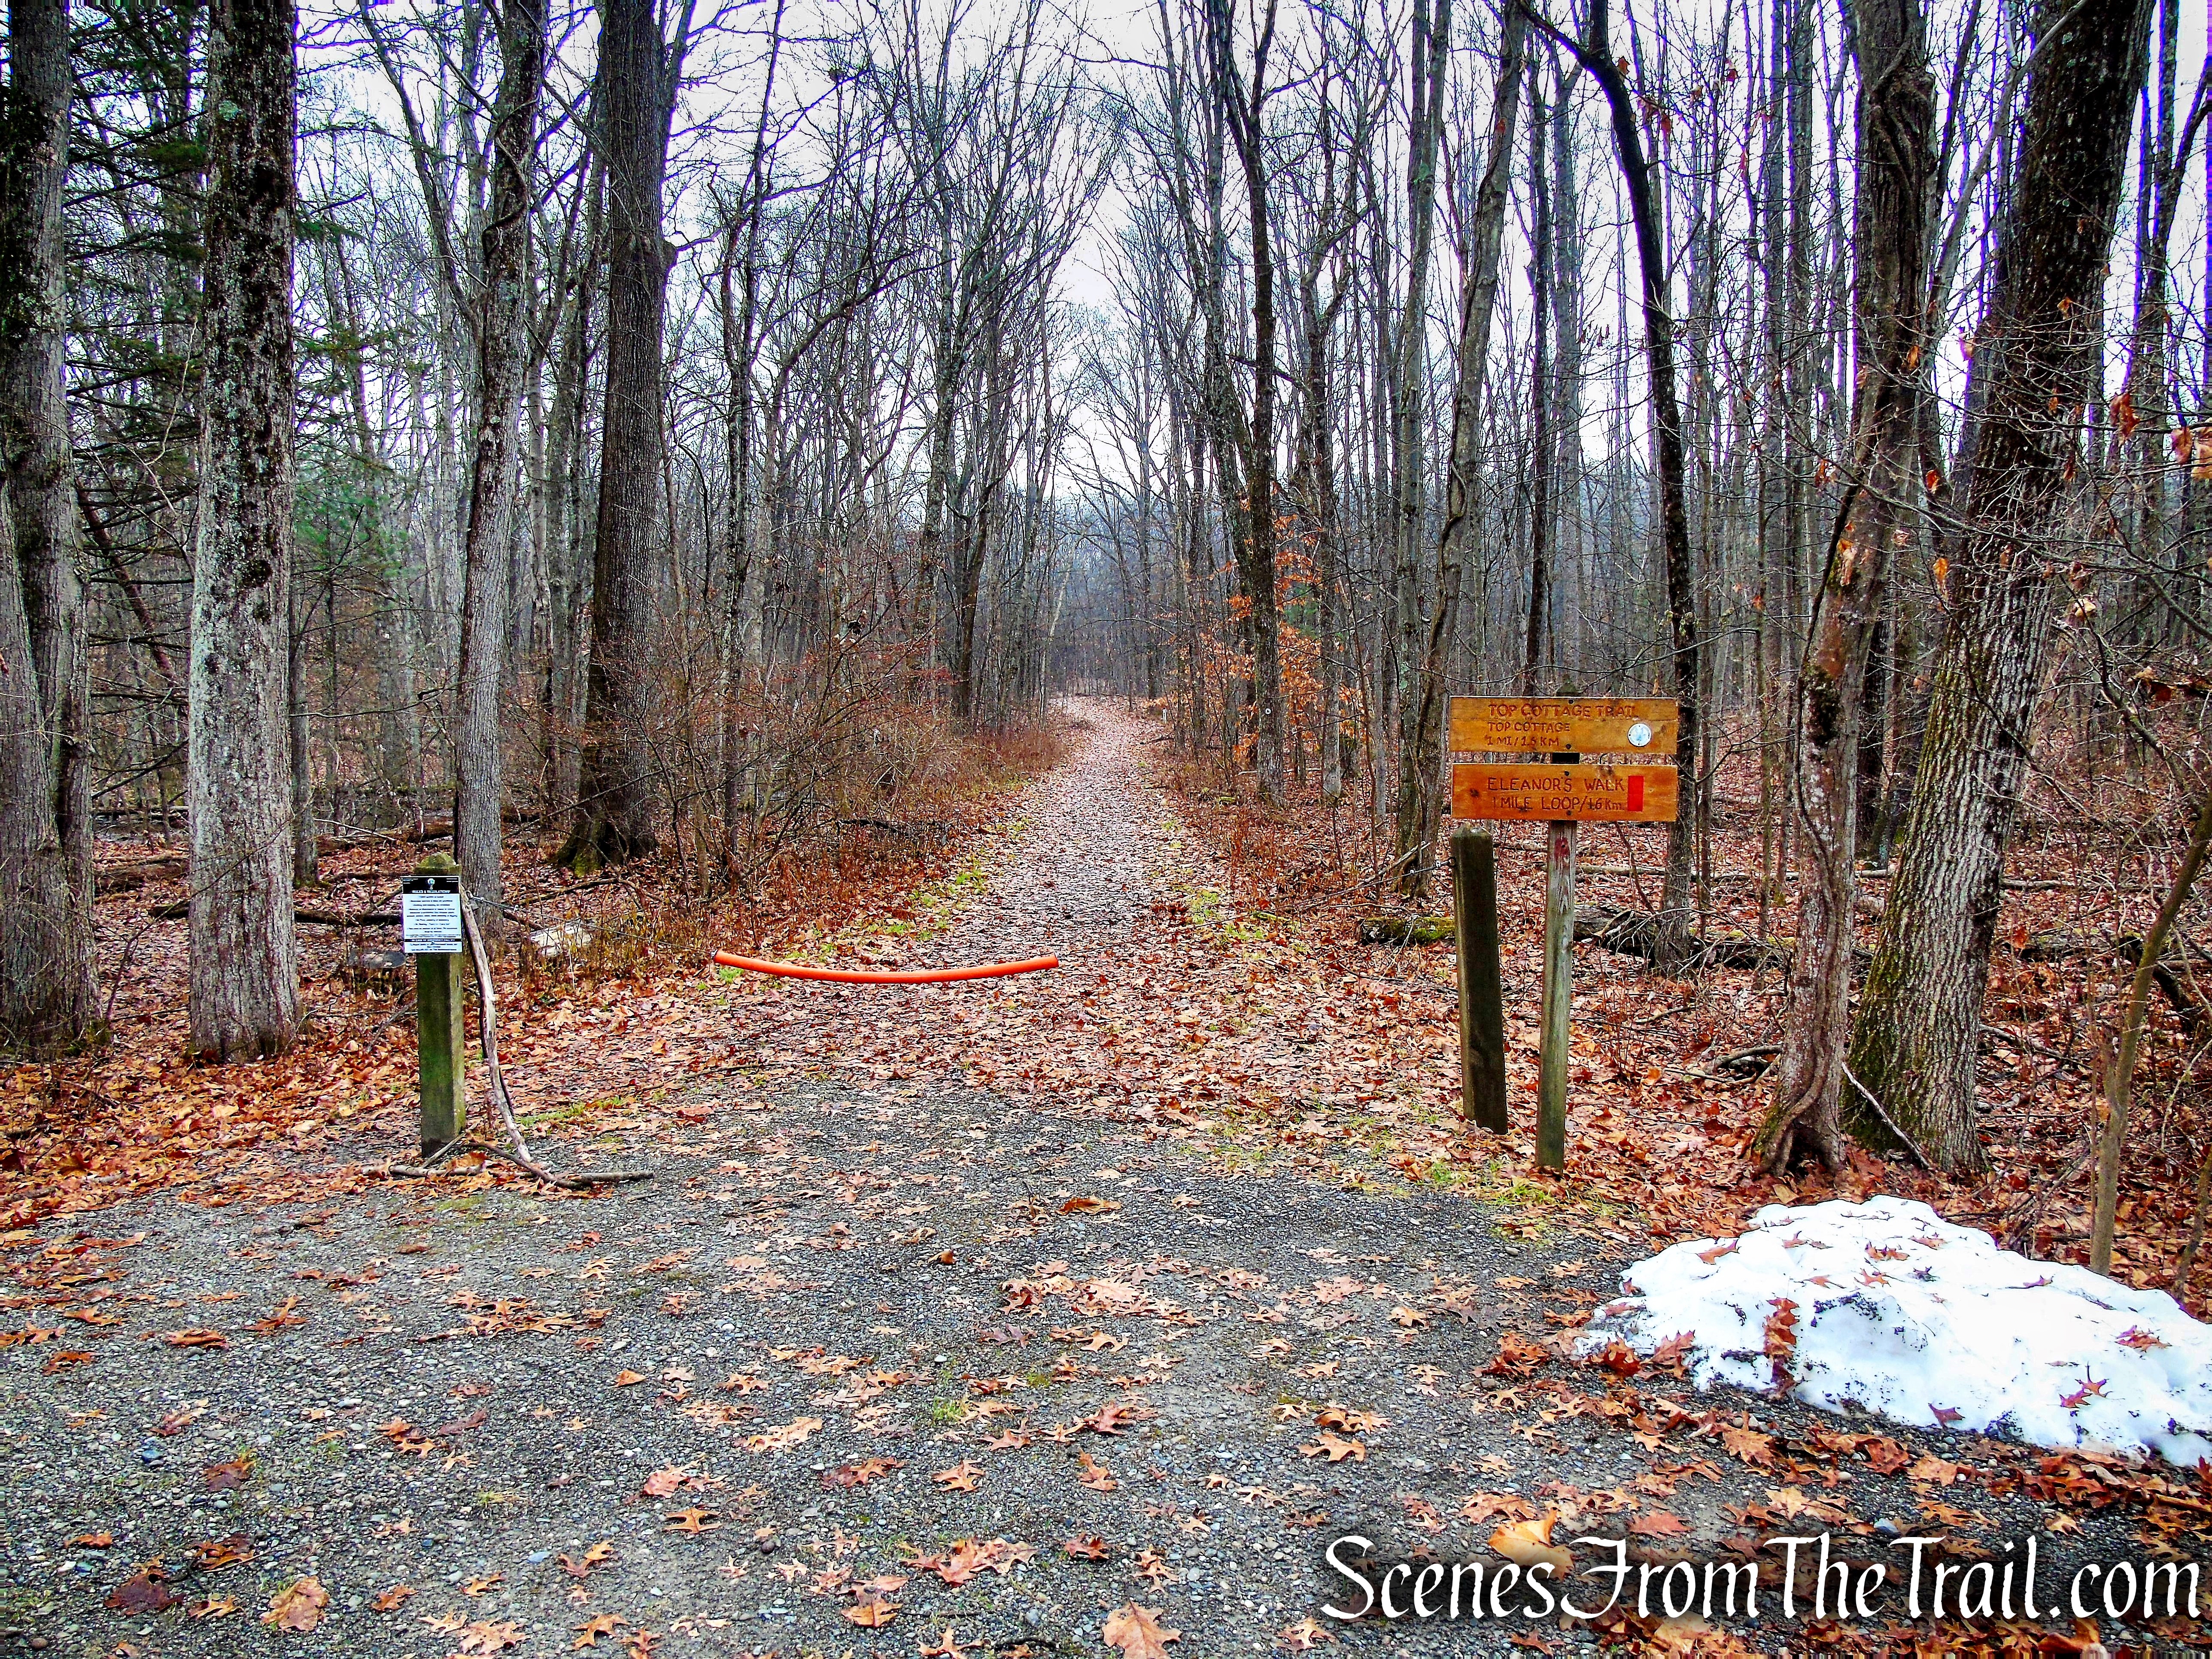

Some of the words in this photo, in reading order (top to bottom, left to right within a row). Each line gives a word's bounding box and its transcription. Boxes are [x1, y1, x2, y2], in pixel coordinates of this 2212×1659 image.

[1488, 704, 1517, 717] TOP
[1521, 703, 1591, 717] COTTAGE
[1595, 705, 1639, 717] TRAIL
[1487, 722, 1511, 732] TOP
[1514, 722, 1571, 733] COTTAGE
[1488, 777, 1572, 792] ELEANOR'S
[1584, 778, 1625, 791] WALK
[1501, 796, 1533, 809] MILE
